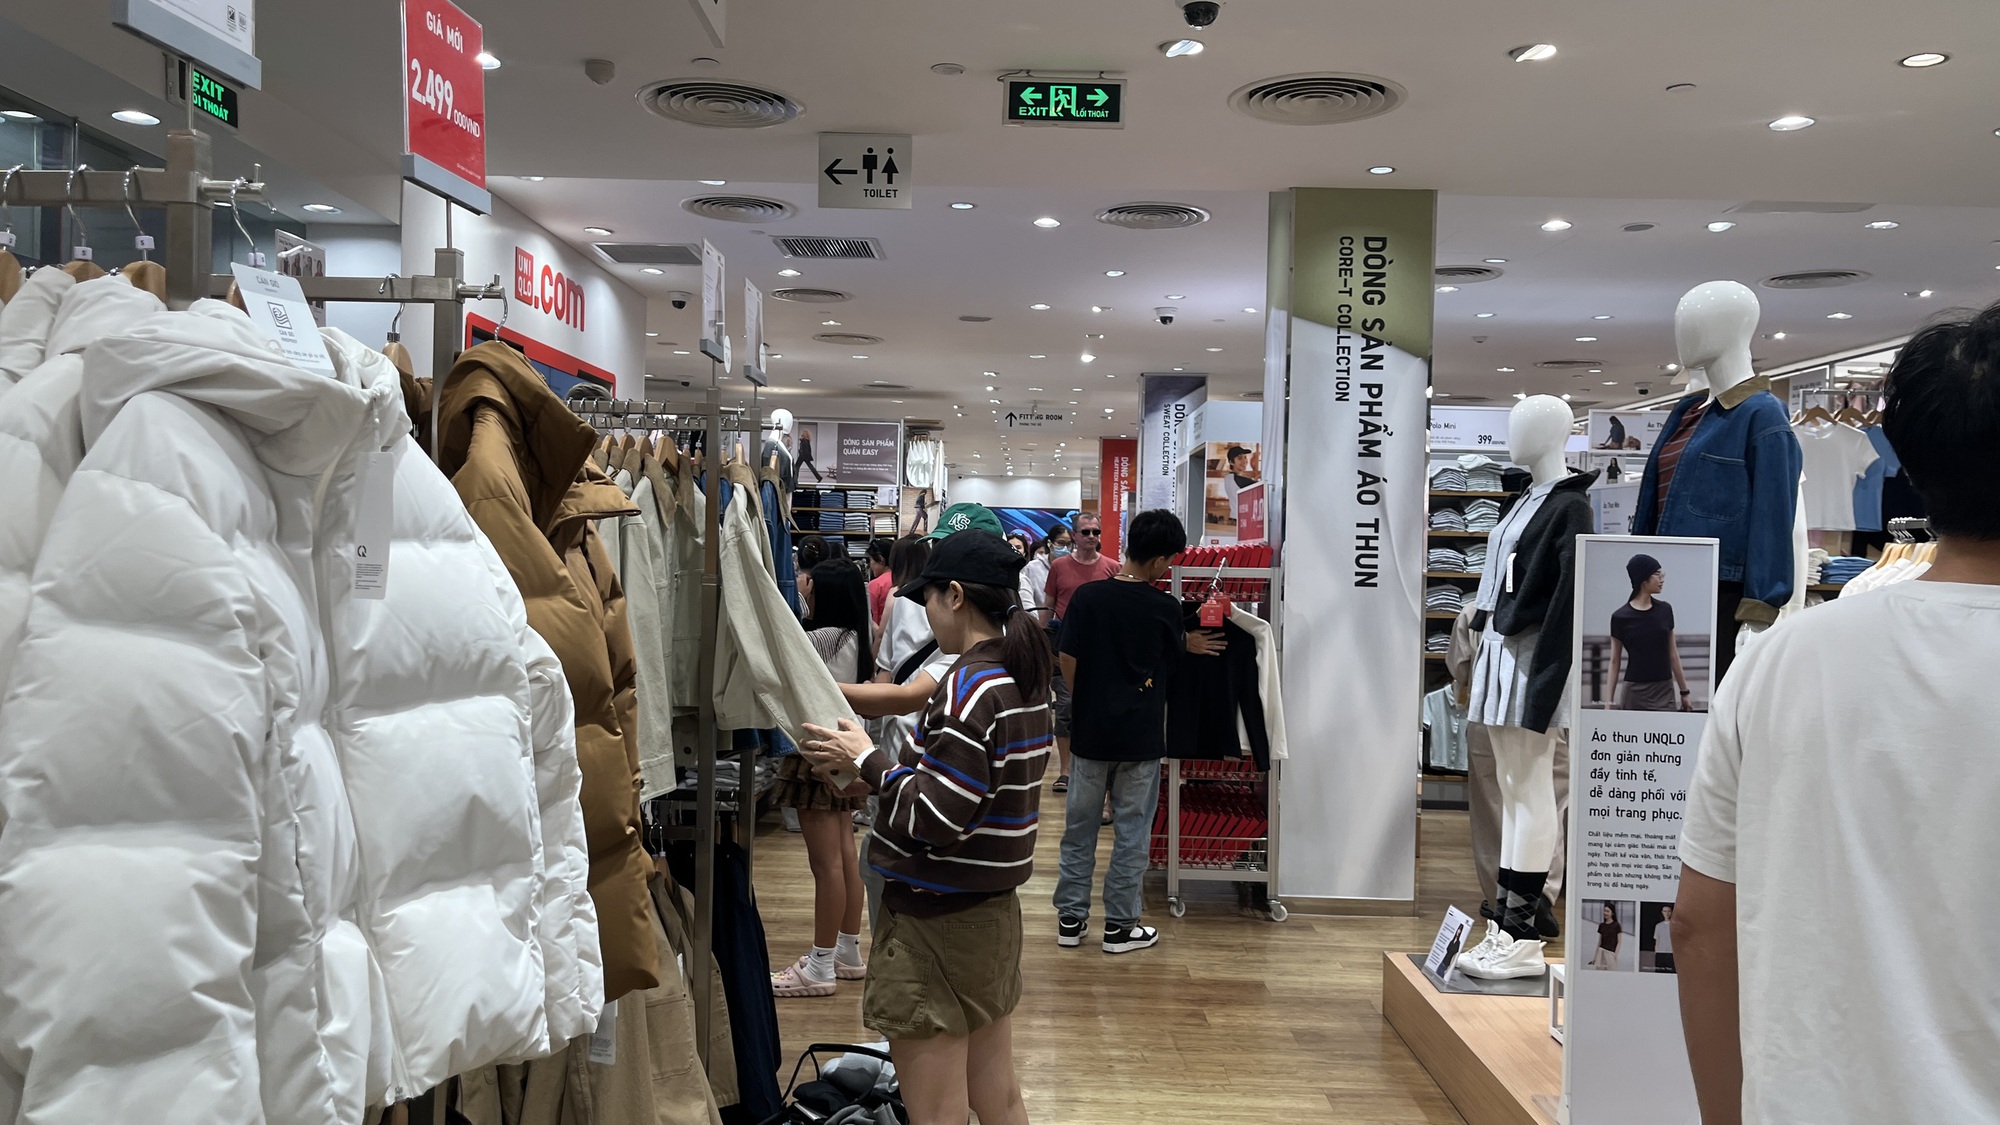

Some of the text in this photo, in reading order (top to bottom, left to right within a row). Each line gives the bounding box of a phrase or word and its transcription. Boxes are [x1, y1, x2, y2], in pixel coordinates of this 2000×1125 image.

[426, 11, 463, 54] GIÁ MỚI
[411, 58, 454, 120] 2.499
[202, 97, 229, 121] THOÁT
[1018, 106, 1048, 116] EXIT
[1076, 108, 1110, 118] LỐI THOÁT
[863, 188, 898, 198] TOILET
[518, 254, 532, 277] UNI
[518, 276, 532, 297] QLO
[534, 264, 585, 332] .com
[1335, 236, 1354, 402] CORE-T COLLECTION
[1354, 236, 1394, 588] DÒNG SẢN PHẨM ÁO THUN
[843, 437, 860, 446] DÒNG
[1478, 434, 1492, 444] 399
[1162, 432, 1170, 476] COLLECTION
[1591, 728, 1685, 746] Áo thun UNQLO
[1590, 749, 1681, 766] đơn giản nhưng
[1616, 769, 1637, 780] tinh
[1643, 769, 1657, 782] tế,
[1590, 785, 1686, 802] dễ dàng phối với
[1589, 806, 1682, 822] mọi trang phục.
